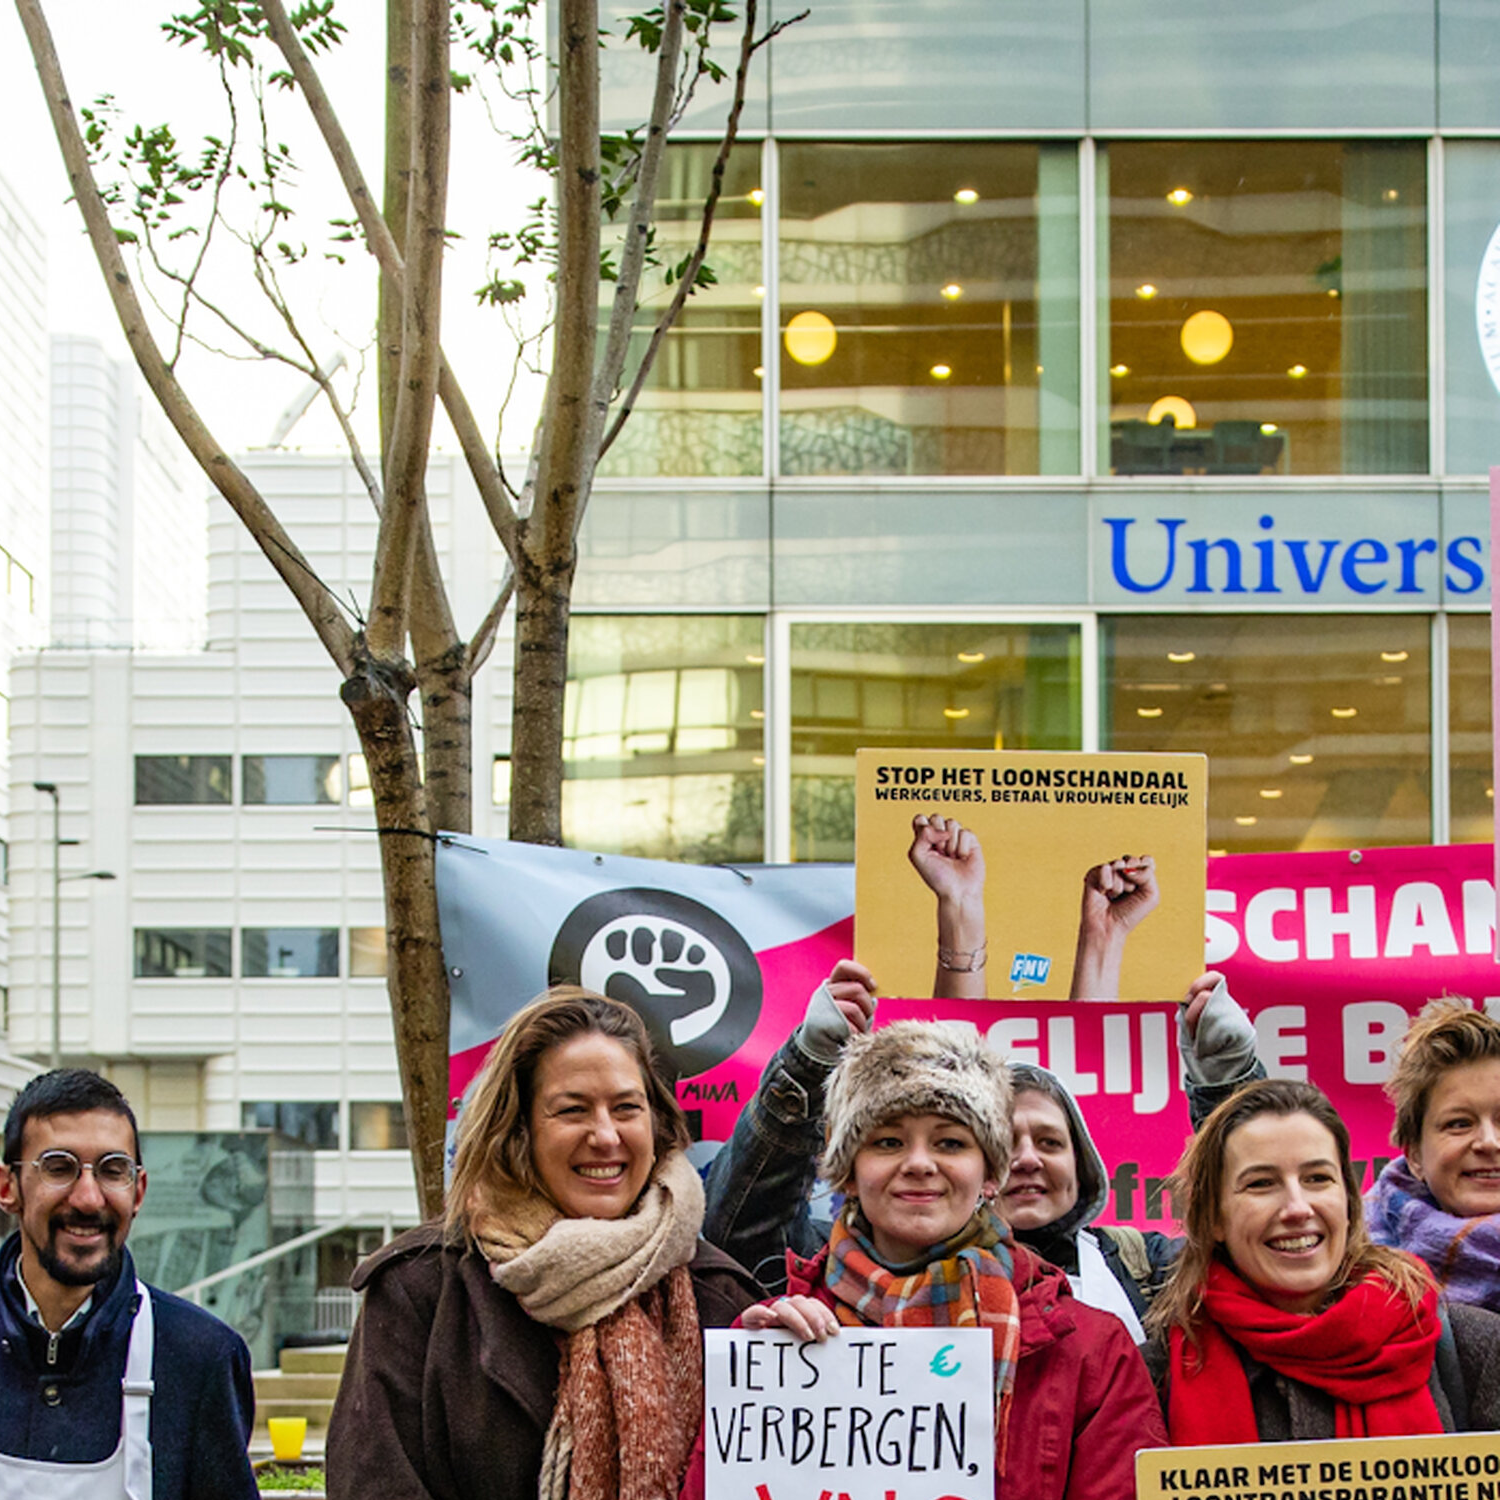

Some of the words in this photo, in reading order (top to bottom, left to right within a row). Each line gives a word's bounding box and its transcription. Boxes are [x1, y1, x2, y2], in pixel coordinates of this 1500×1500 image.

[1103, 515, 1488, 594] Univers
[876, 766, 935, 785] STOP
[942, 768, 985, 786] HET
[992, 769, 1188, 790] LOONSCHANDAAL
[875, 787, 987, 803] WERKGEVERS,
[991, 789, 1050, 803] BETAAL
[1054, 790, 1135, 805] VROUWEN
[1139, 792, 1189, 809] GELIJK
[681, 1080, 739, 1103] MINA
[730, 1338, 822, 1391] IETS
[848, 1342, 897, 1396] TE
[711, 1402, 979, 1477] VERBERGEN,
[1160, 1466, 1249, 1490] KLAAR
[1258, 1463, 1311, 1486] MET
[1319, 1461, 1352, 1483] DE
